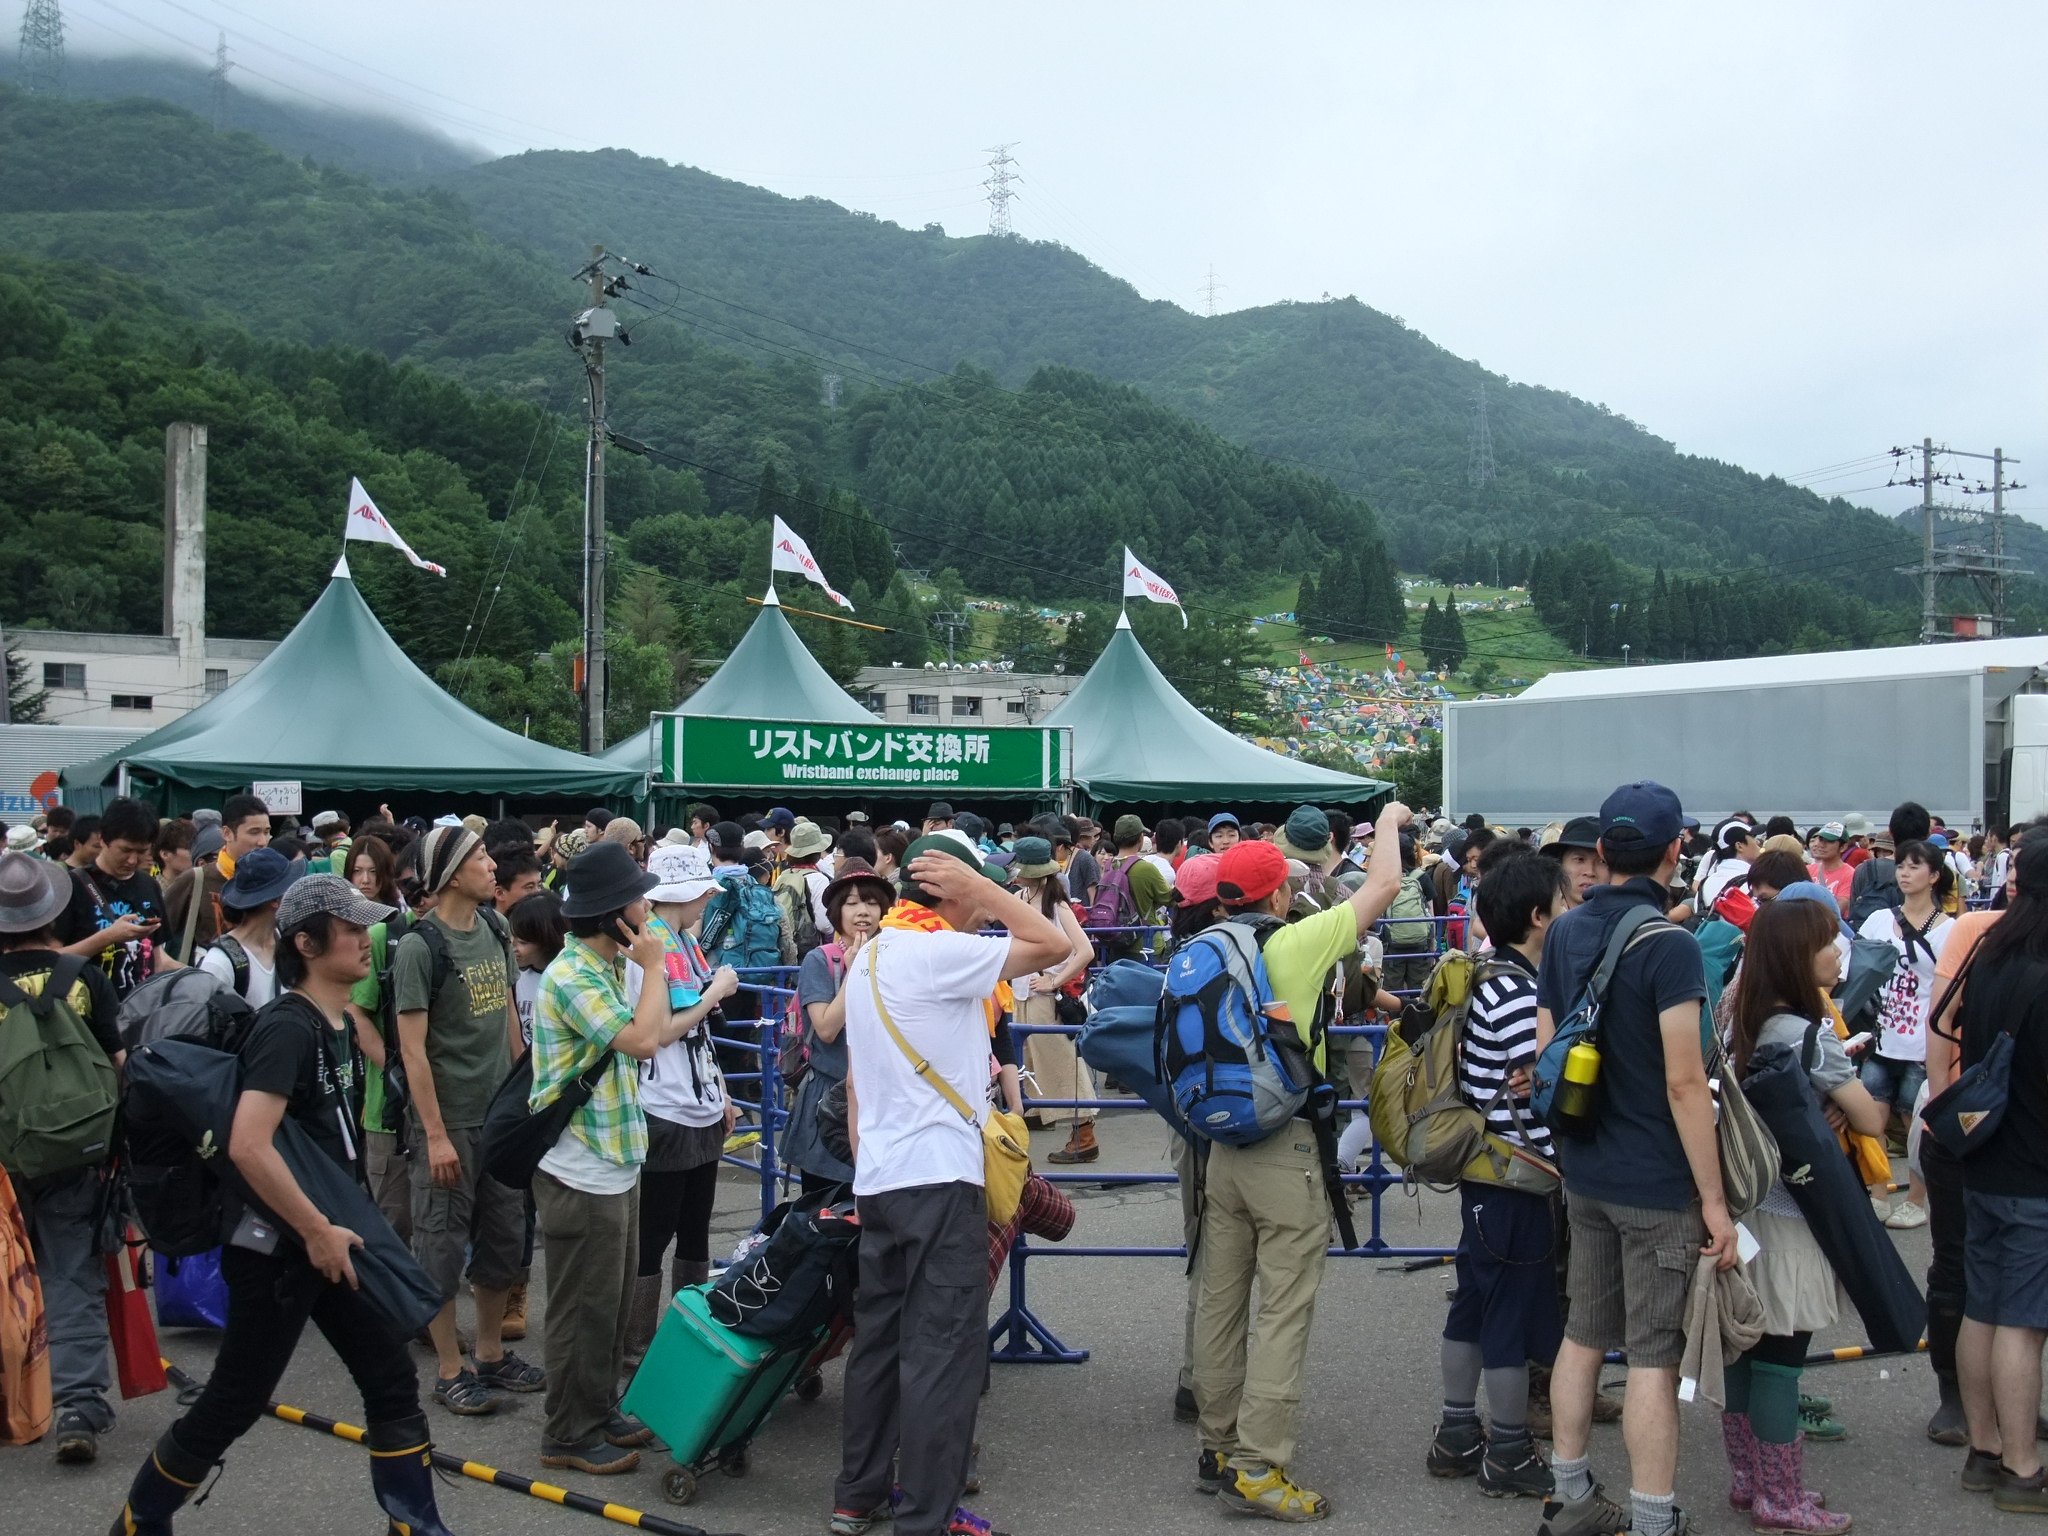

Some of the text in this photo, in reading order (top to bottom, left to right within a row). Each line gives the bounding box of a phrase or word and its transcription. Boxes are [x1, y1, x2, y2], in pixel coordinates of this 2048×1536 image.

[749, 729, 990, 764] リストバンド交換所
[782, 763, 960, 783] Wristband exchange place
